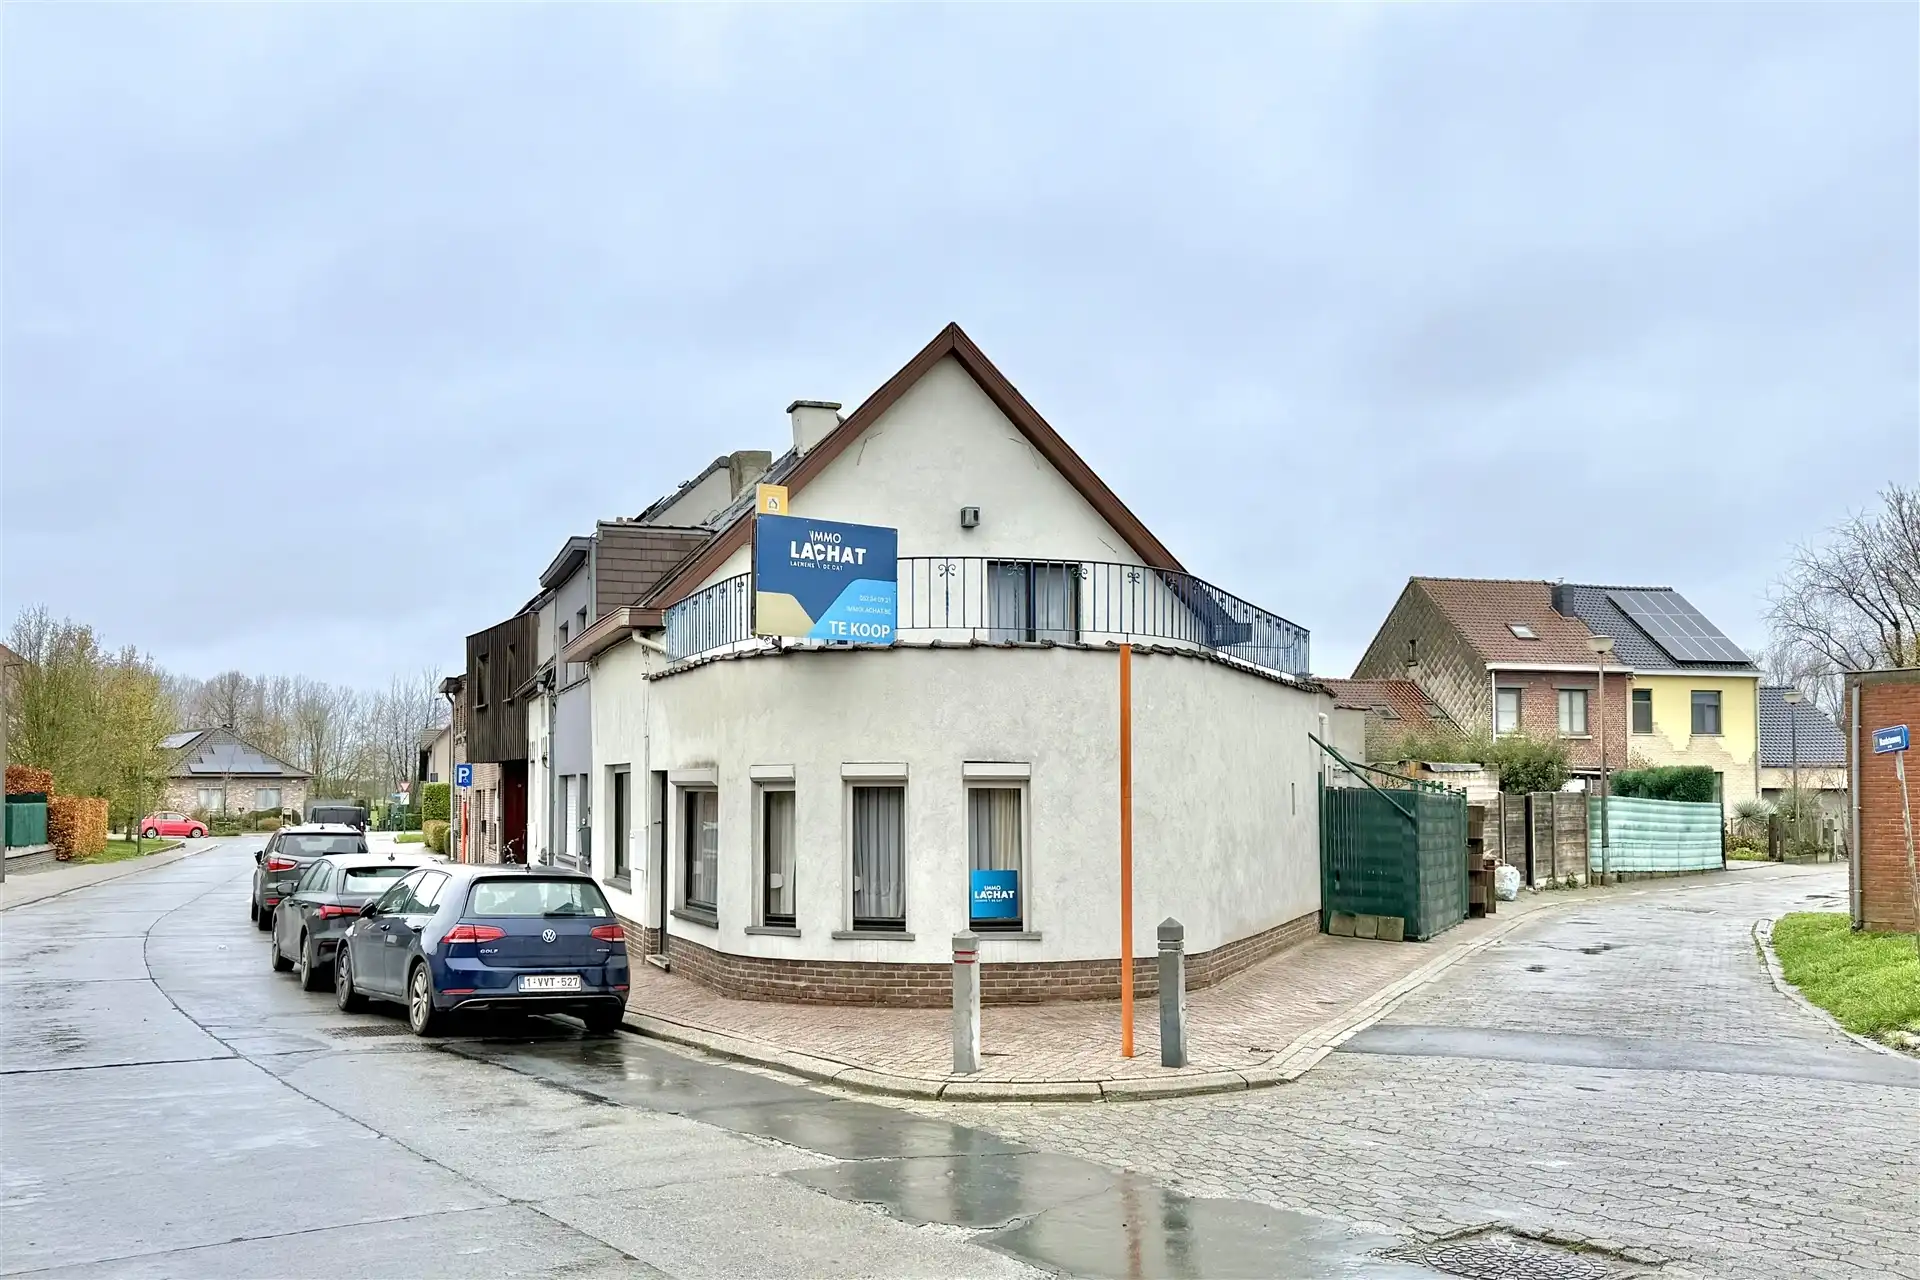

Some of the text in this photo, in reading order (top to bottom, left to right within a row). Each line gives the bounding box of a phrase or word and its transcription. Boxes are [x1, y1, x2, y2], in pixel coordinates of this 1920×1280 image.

[809, 530, 841, 544] IMMO
[790, 540, 866, 564] LACHAT
[829, 620, 891, 638] TE KOOP
[459, 768, 469, 784] P
[974, 890, 1014, 898] LACHAT
